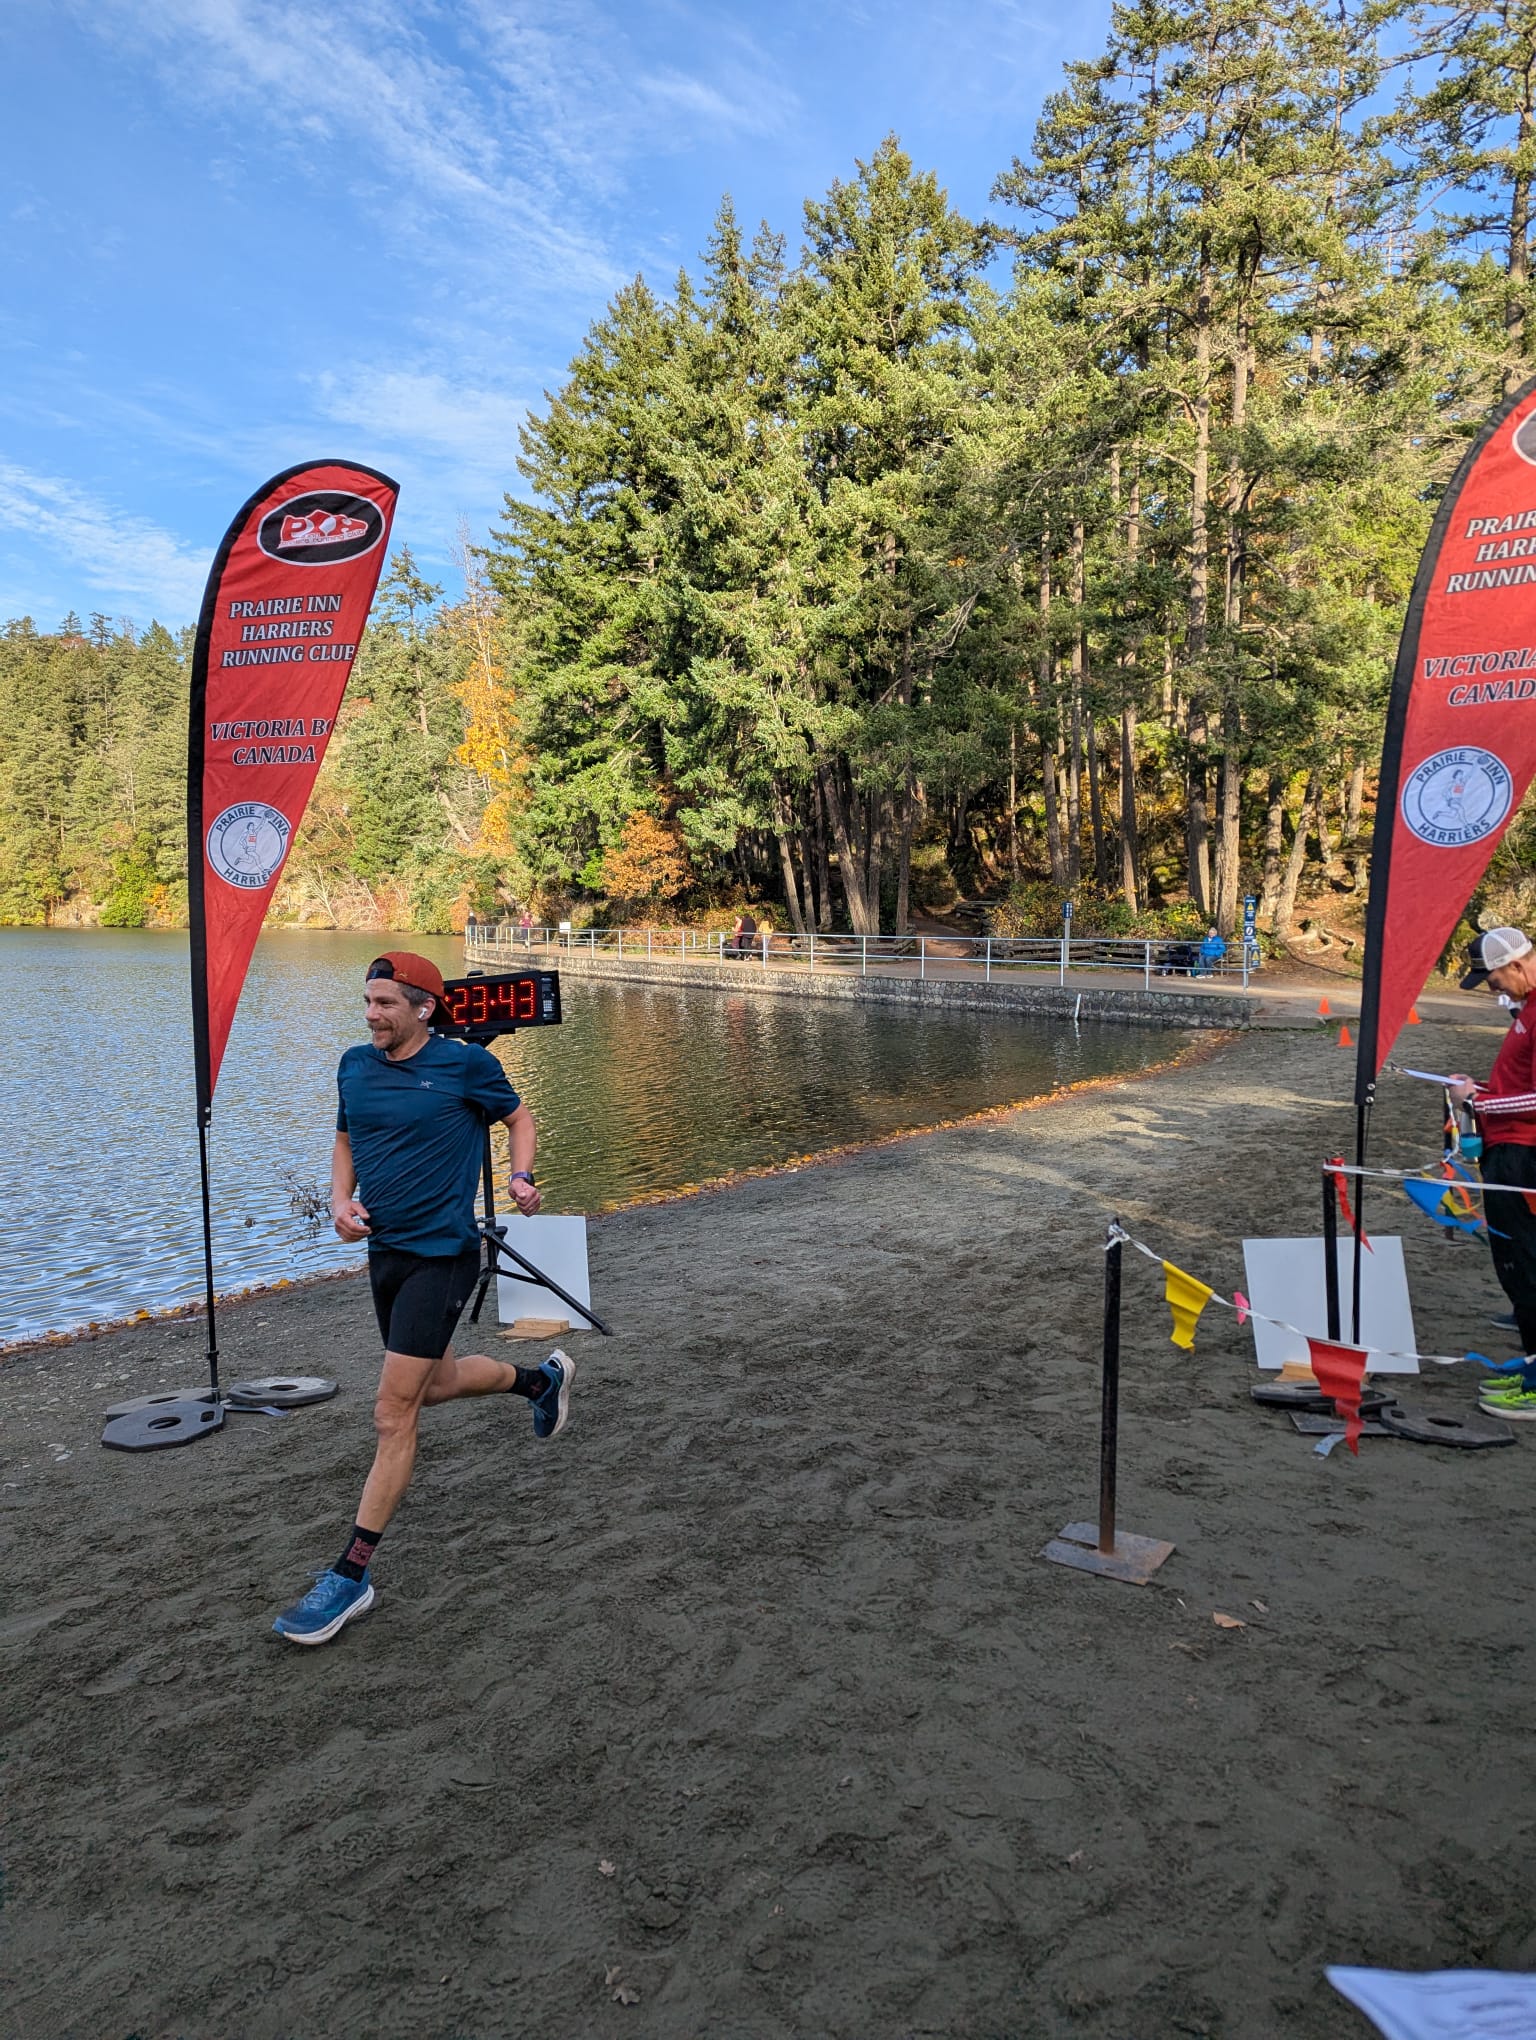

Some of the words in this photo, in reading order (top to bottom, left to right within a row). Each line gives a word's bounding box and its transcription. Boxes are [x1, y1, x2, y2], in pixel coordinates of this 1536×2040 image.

[229, 597, 303, 619] PRAIRIE
[306, 594, 342, 612] INN
[240, 620, 334, 642] HARRIERS
[221, 645, 304, 668] RUNNING
[308, 644, 356, 662] CLUB
[1447, 678, 1536, 708] CANAD
[210, 718, 306, 741] VICTORIA
[232, 744, 317, 766] CANADA
[1416, 751, 1467, 783] PRAIRIE
[1486, 761, 1506, 786] INN
[215, 806, 255, 833] PRAIRIE
[271, 816, 289, 837] INN
[1418, 819, 1491, 842] HARRIERS
